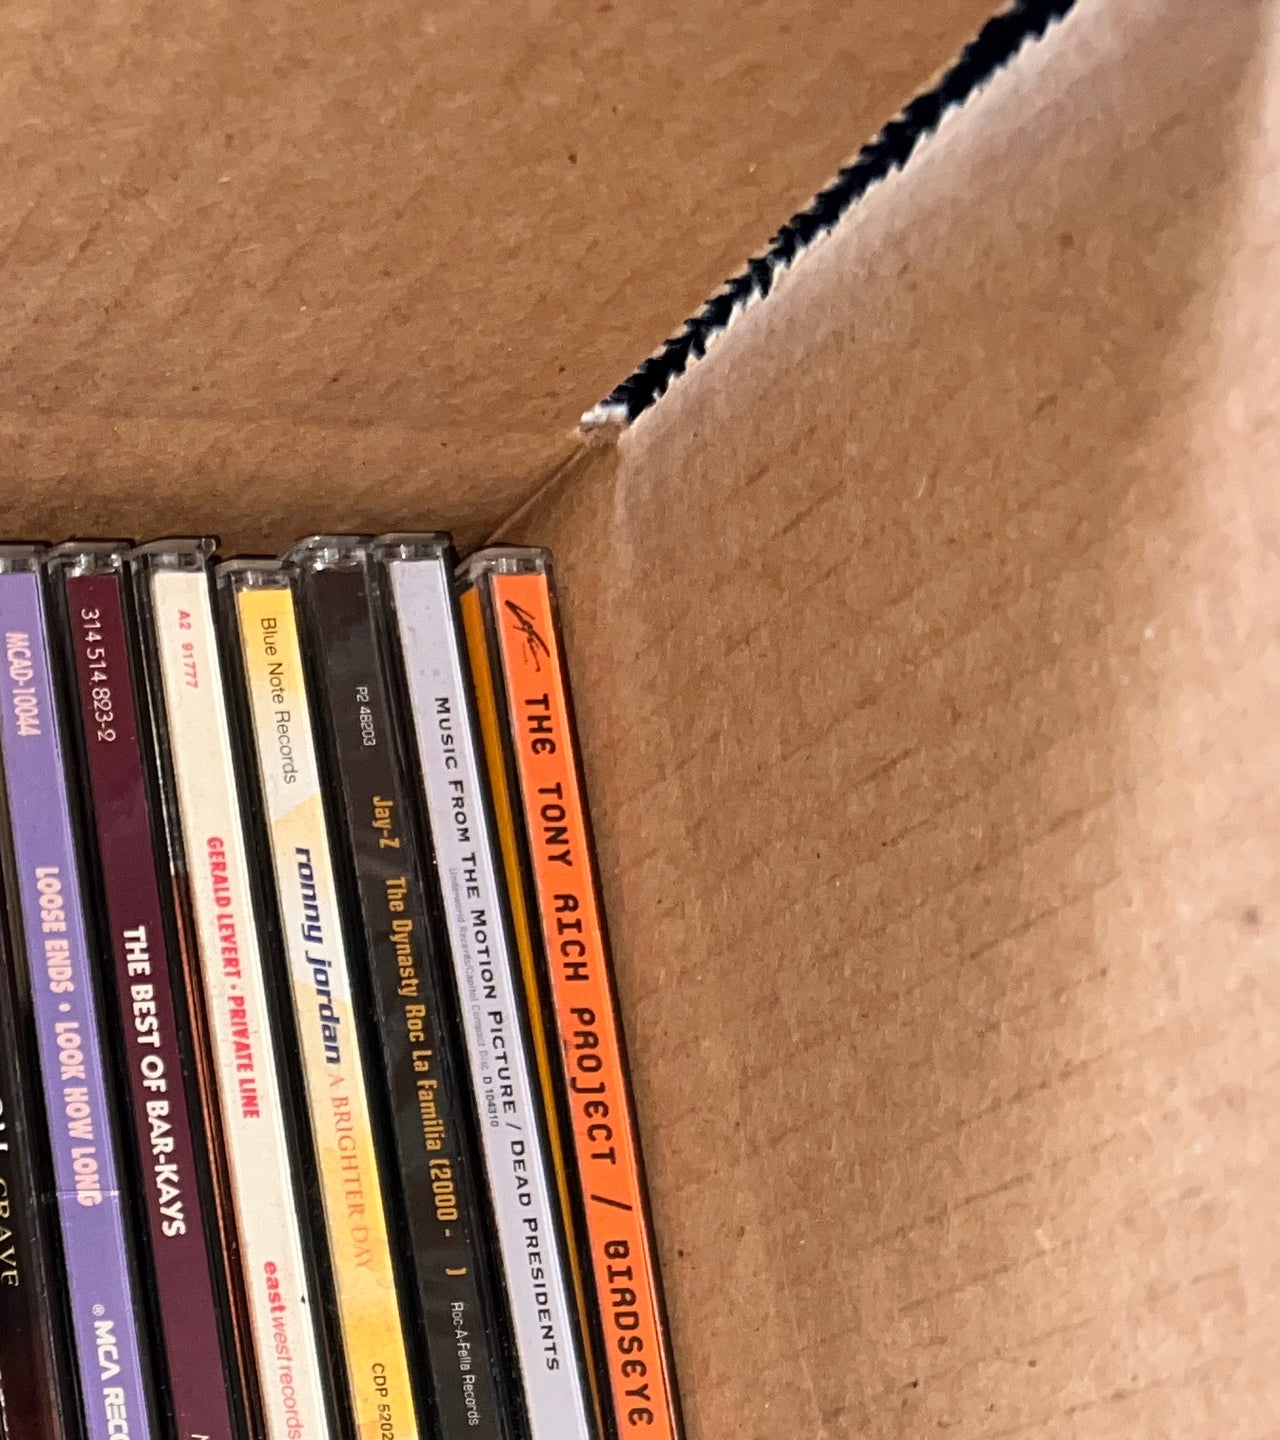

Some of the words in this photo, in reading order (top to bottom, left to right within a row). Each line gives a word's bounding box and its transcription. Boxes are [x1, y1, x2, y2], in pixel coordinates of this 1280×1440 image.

[181, 643, 196, 688] 91777
[260, 617, 285, 657] Blue
[4, 632, 40, 736] MCAD-10044
[89, 687, 115, 742] 823-2
[266, 662, 289, 705] Note
[273, 711, 300, 784] Records
[537, 783, 571, 867] TONY
[34, 866, 67, 932] LOOSE
[205, 837, 230, 907] GERALD
[295, 847, 322, 944] ronny
[44, 939, 74, 993] ENDS
[216, 914, 241, 979] LEVERT
[369, 796, 399, 849] Jay-Z
[390, 919, 421, 997] Dynasty
[415, 1080, 446, 1151] Familia
[552, 893, 588, 983] RICH
[227, 999, 254, 1071] PRIVATE
[303, 950, 344, 1064] jordan
[127, 984, 158, 1047] BEST
[144, 1099, 187, 1237] BAR-KAYS
[567, 1008, 615, 1168] PROJECT
[604, 1240, 654, 1427] BIRDSEYE
[459, 1375, 480, 1426] Records
